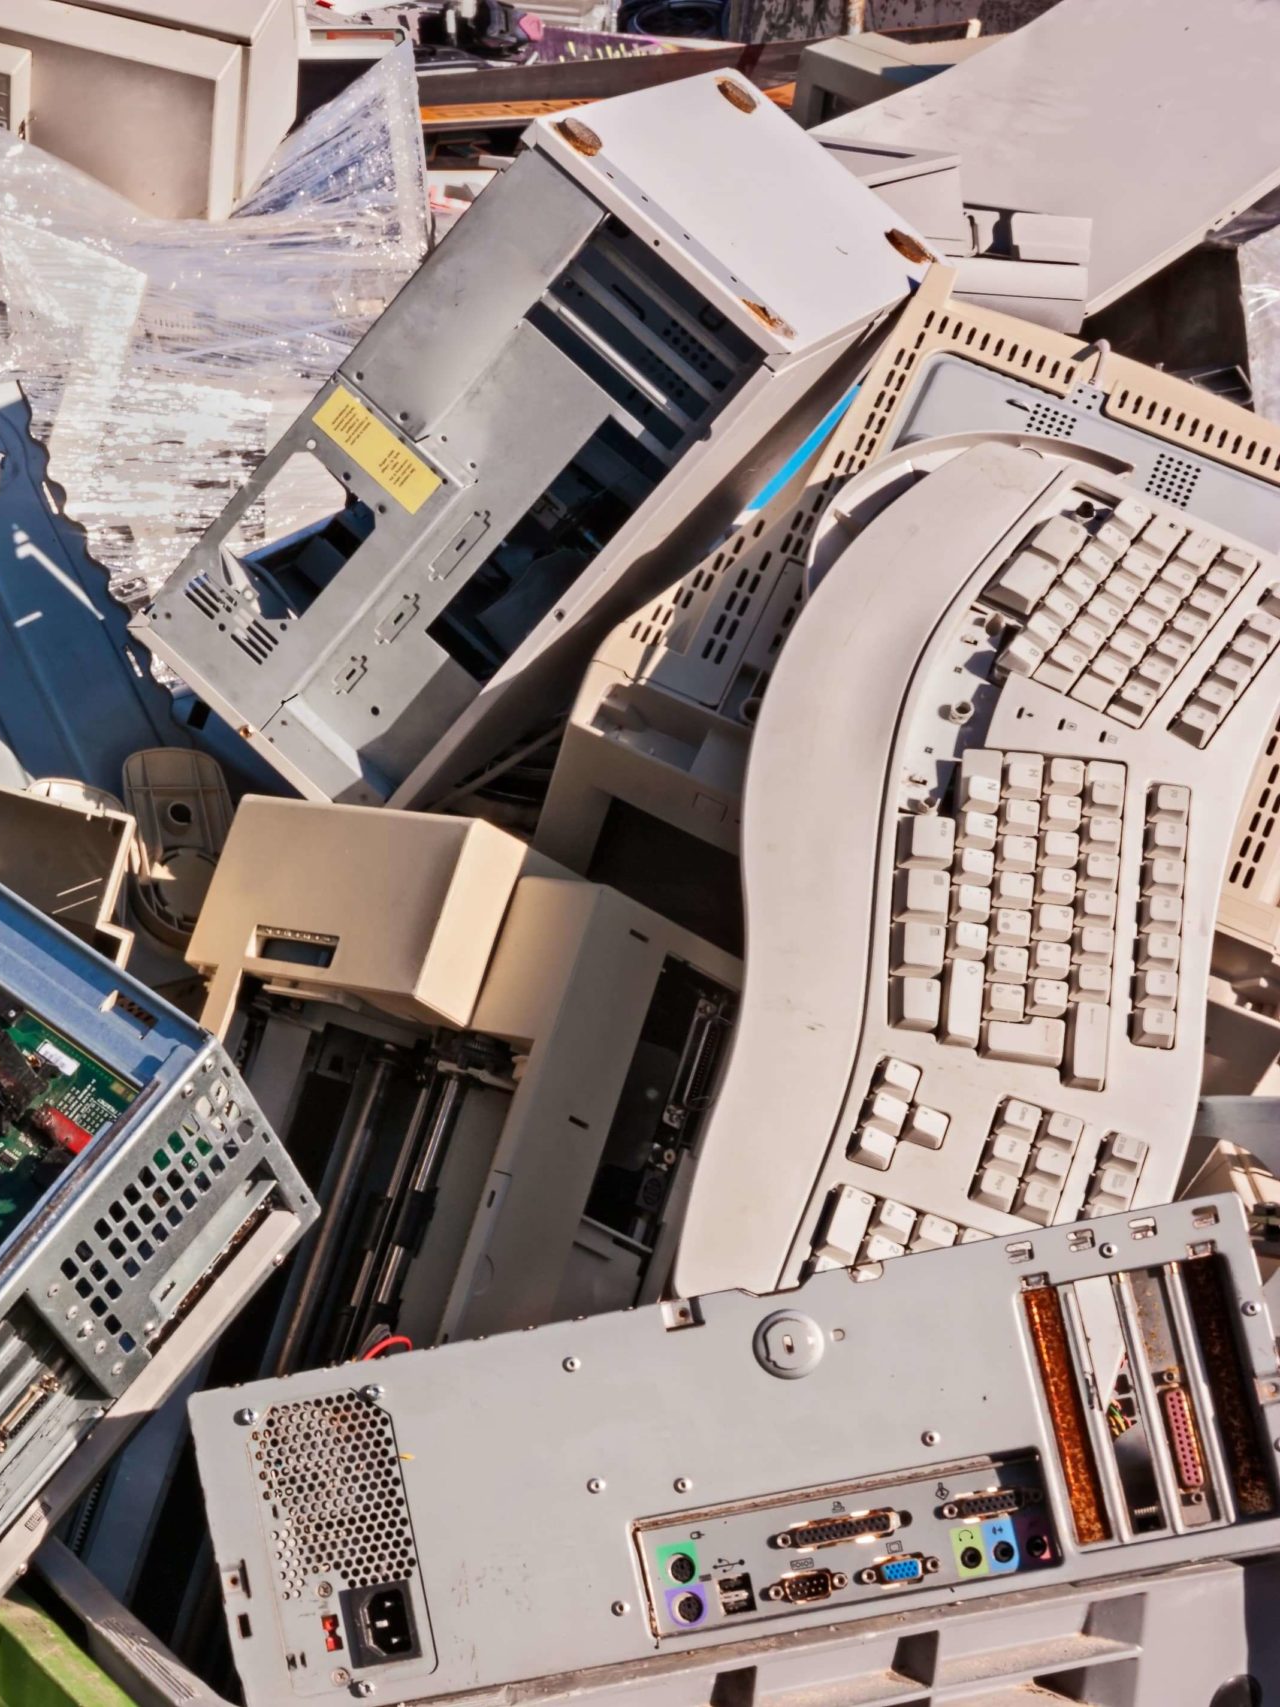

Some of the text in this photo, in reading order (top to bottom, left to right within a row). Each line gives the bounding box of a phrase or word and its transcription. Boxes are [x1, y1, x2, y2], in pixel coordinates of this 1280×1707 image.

[1098, 556, 1109, 566] Z
[1141, 563, 1152, 571] A
[1081, 578, 1092, 588] X
[1125, 586, 1135, 594] S
[1064, 602, 1074, 611] C
[1108, 608, 1118, 616] D
[1148, 617, 1158, 625] E
[1047, 626, 1057, 635] V
[1092, 630, 1101, 639] F
[1130, 640, 1140, 649] R
[1029, 648, 1039, 656] B
[1072, 655, 1081, 663] G
[1113, 665, 1124, 673] T
[1070, 764, 1081, 772] Y
[1028, 768, 1039, 777] H
[987, 782, 997, 790] N
[1066, 799, 1077, 807] U
[983, 817, 993, 827] M
[1061, 873, 1071, 881] O
[1059, 909, 1069, 917] P
[860, 1196, 870, 1204] 0
